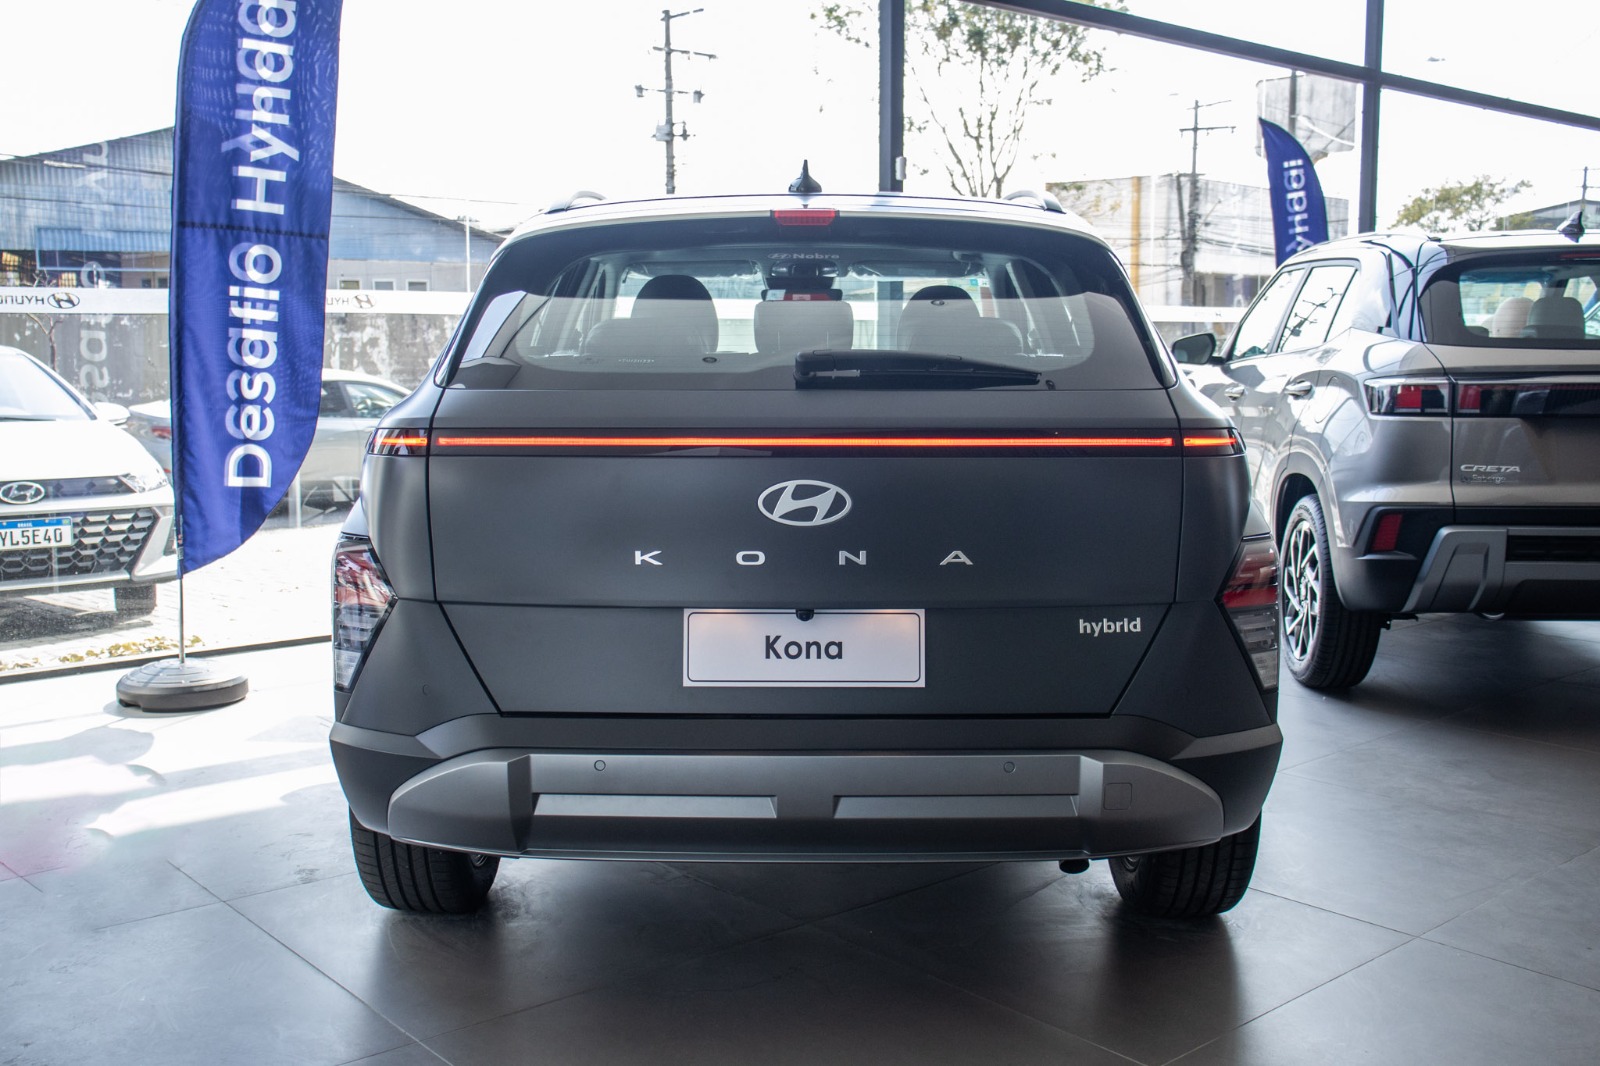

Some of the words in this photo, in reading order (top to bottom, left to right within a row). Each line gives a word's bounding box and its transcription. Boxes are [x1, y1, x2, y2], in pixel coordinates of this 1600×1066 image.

[225, 243, 283, 488] Desafio
[1460, 464, 1521, 473] CRETA
[634, 550, 974, 566] KONA
[1078, 616, 1142, 636] hybrid
[764, 634, 844, 661] Kona
